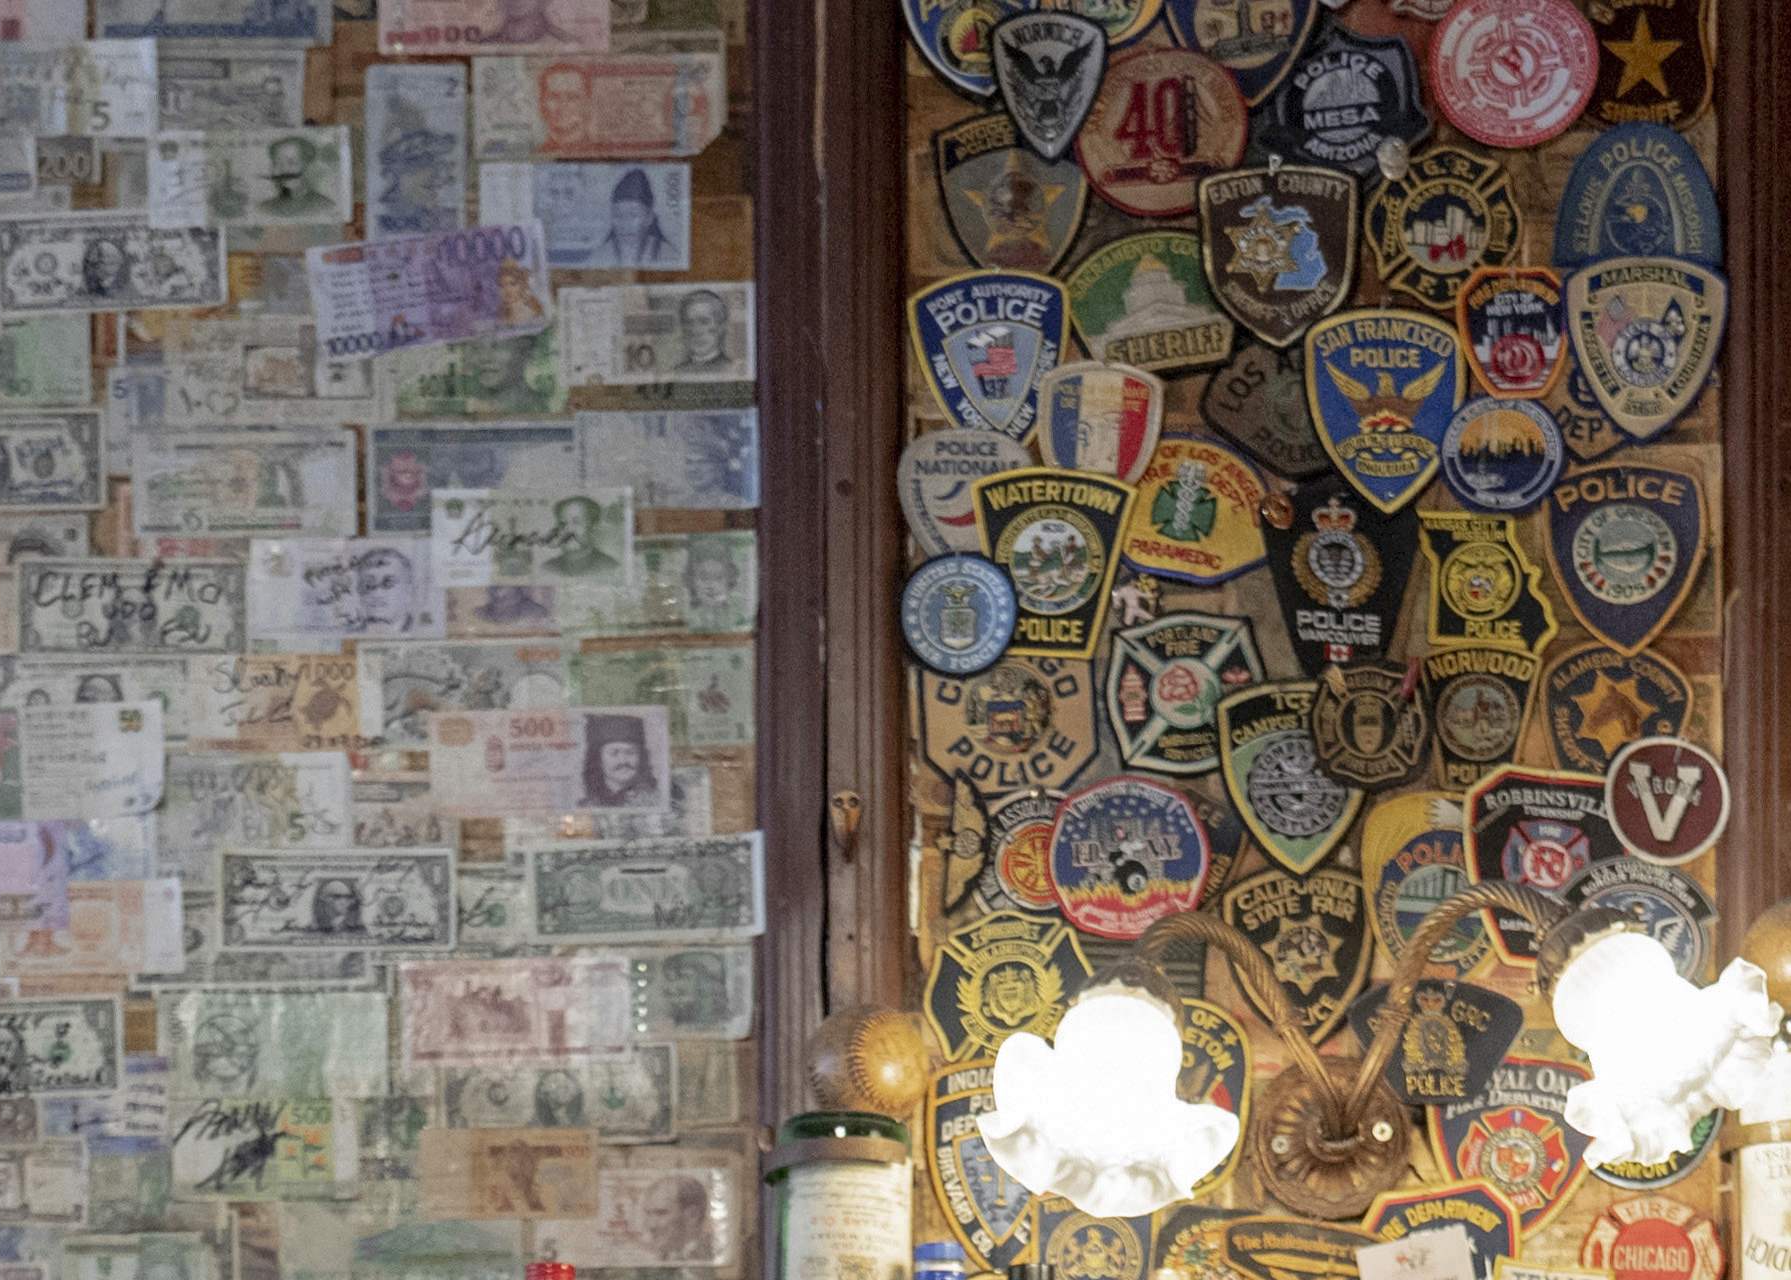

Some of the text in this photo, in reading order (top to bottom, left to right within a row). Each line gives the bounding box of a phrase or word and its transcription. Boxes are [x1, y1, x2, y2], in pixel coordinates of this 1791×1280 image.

[1294, 51, 1383, 88] POLICE
[1304, 106, 1381, 129] MESA
[1601, 100, 1681, 122] SHERIFF
[1305, 133, 1379, 161] ARIZONA
[1601, 138, 1681, 174] POLICE
[1209, 172, 1349, 204] EATON COUNTY
[1601, 266, 1693, 290] MARSHAL
[926, 285, 1052, 312] PORT AUTHORITY
[936, 298, 1049, 336] POLICE
[1108, 322, 1225, 363] SHERIFF
[1315, 321, 1453, 357] SAN FRANCISCO
[624, 343, 657, 371] 10
[1350, 348, 1431, 369] POLICE
[934, 441, 998, 457] POLICE
[985, 479, 1121, 515] WATERTOWN
[1555, 476, 1688, 512] POLICE
[1129, 538, 1222, 571] PARAMEDIC
[1016, 619, 1084, 644] POLICE
[1296, 610, 1382, 631] POLICE
[1465, 621, 1522, 640] POLICE
[1145, 625, 1218, 646] PORTLAND
[1164, 637, 1201, 656] FIRE
[1299, 631, 1381, 647] VANCOUVER
[949, 636, 1004, 670] FORCE
[1427, 653, 1535, 682] NORWOOD
[1553, 656, 1623, 690] ALAMEDA
[508, 716, 555, 739] 500
[946, 733, 1076, 787] POLICE
[1523, 806, 1585, 821] TOWNSHIP
[1236, 879, 1357, 911] CALIFORNIA
[1241, 899, 1358, 930] STATE FAIR
[1451, 1000, 1492, 1032] GRC
[1406, 1074, 1467, 1098] POLICE
[1404, 1199, 1502, 1234] DEPARTMENT
[1623, 1204, 1681, 1220] FIRE
[1613, 1244, 1690, 1274] CHICAGO
